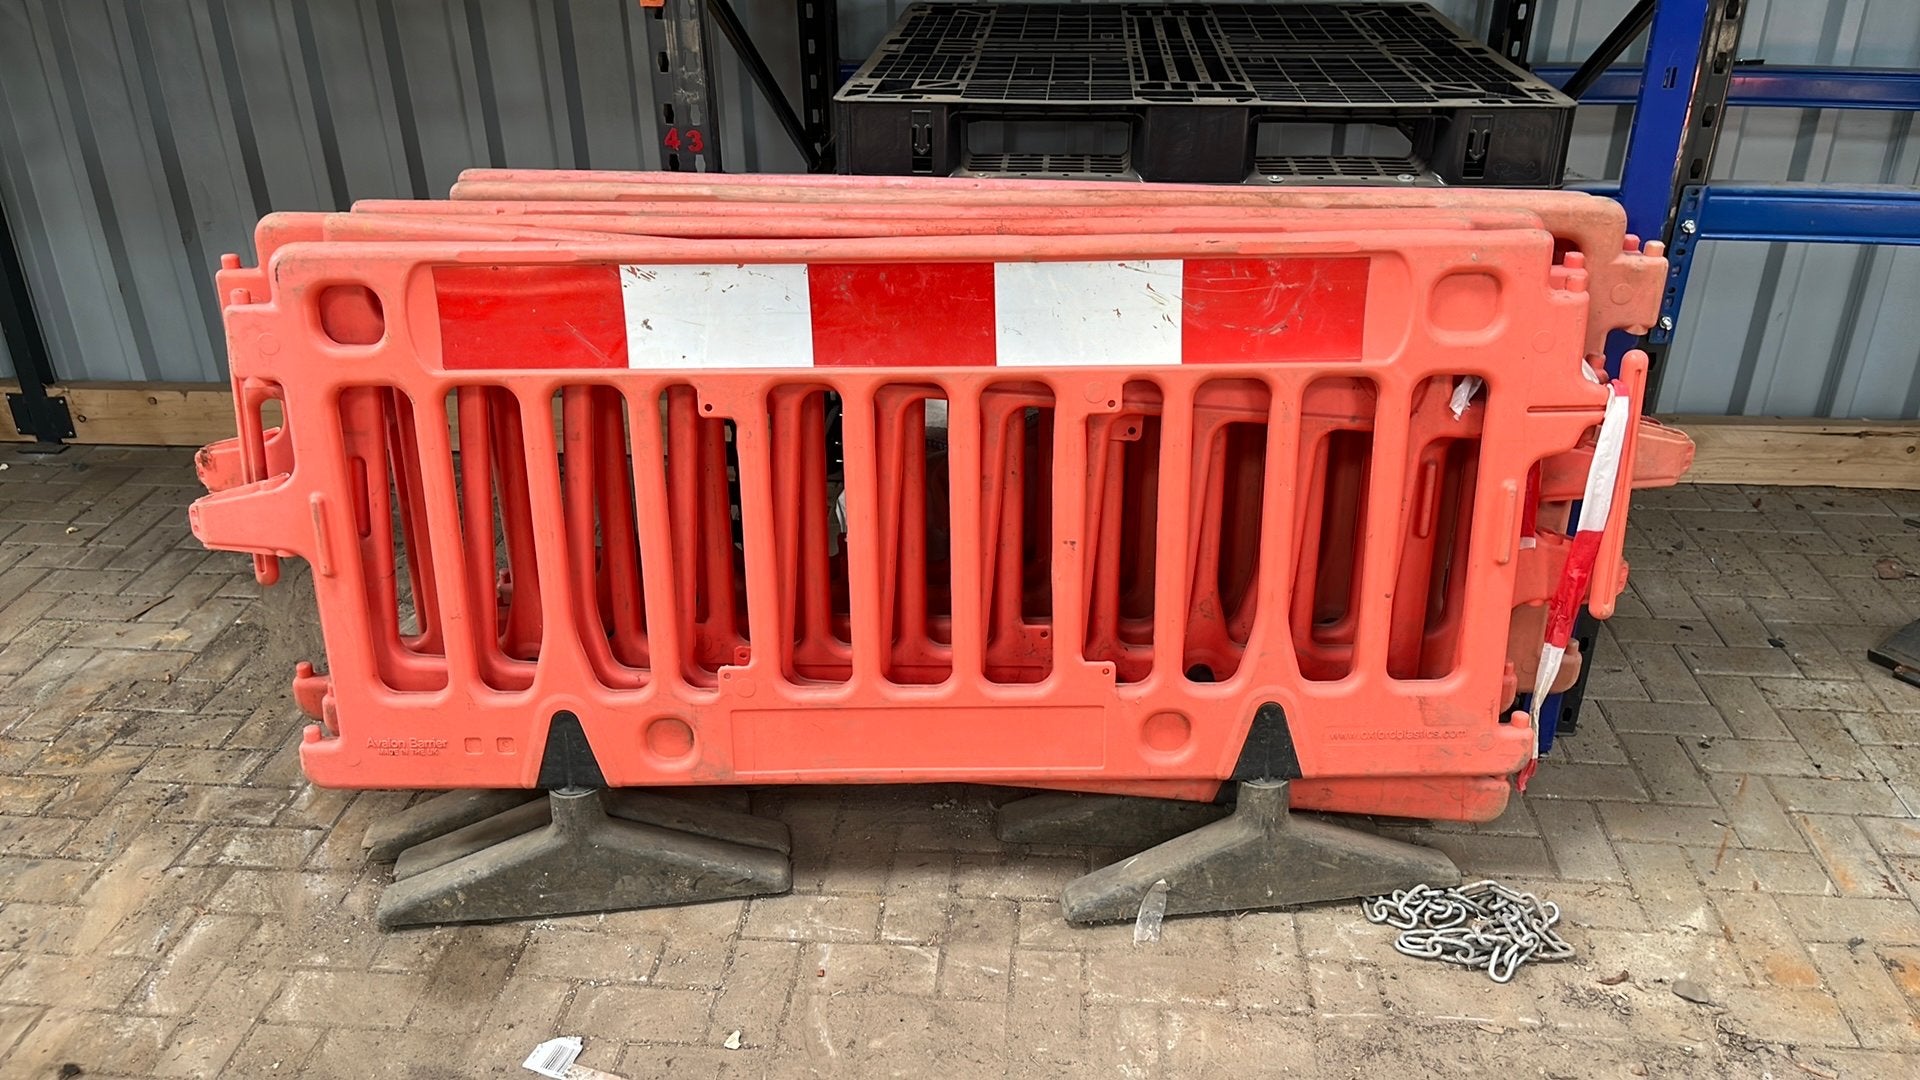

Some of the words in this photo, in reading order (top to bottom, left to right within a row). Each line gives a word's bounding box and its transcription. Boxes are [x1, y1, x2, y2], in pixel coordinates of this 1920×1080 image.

[367, 737, 406, 749] Avalon
[409, 737, 448, 749] Barrier
[378, 748, 399, 756] MADE
[400, 748, 409, 756] IN
[410, 748, 426, 756] THE
[427, 748, 439, 756] UK
